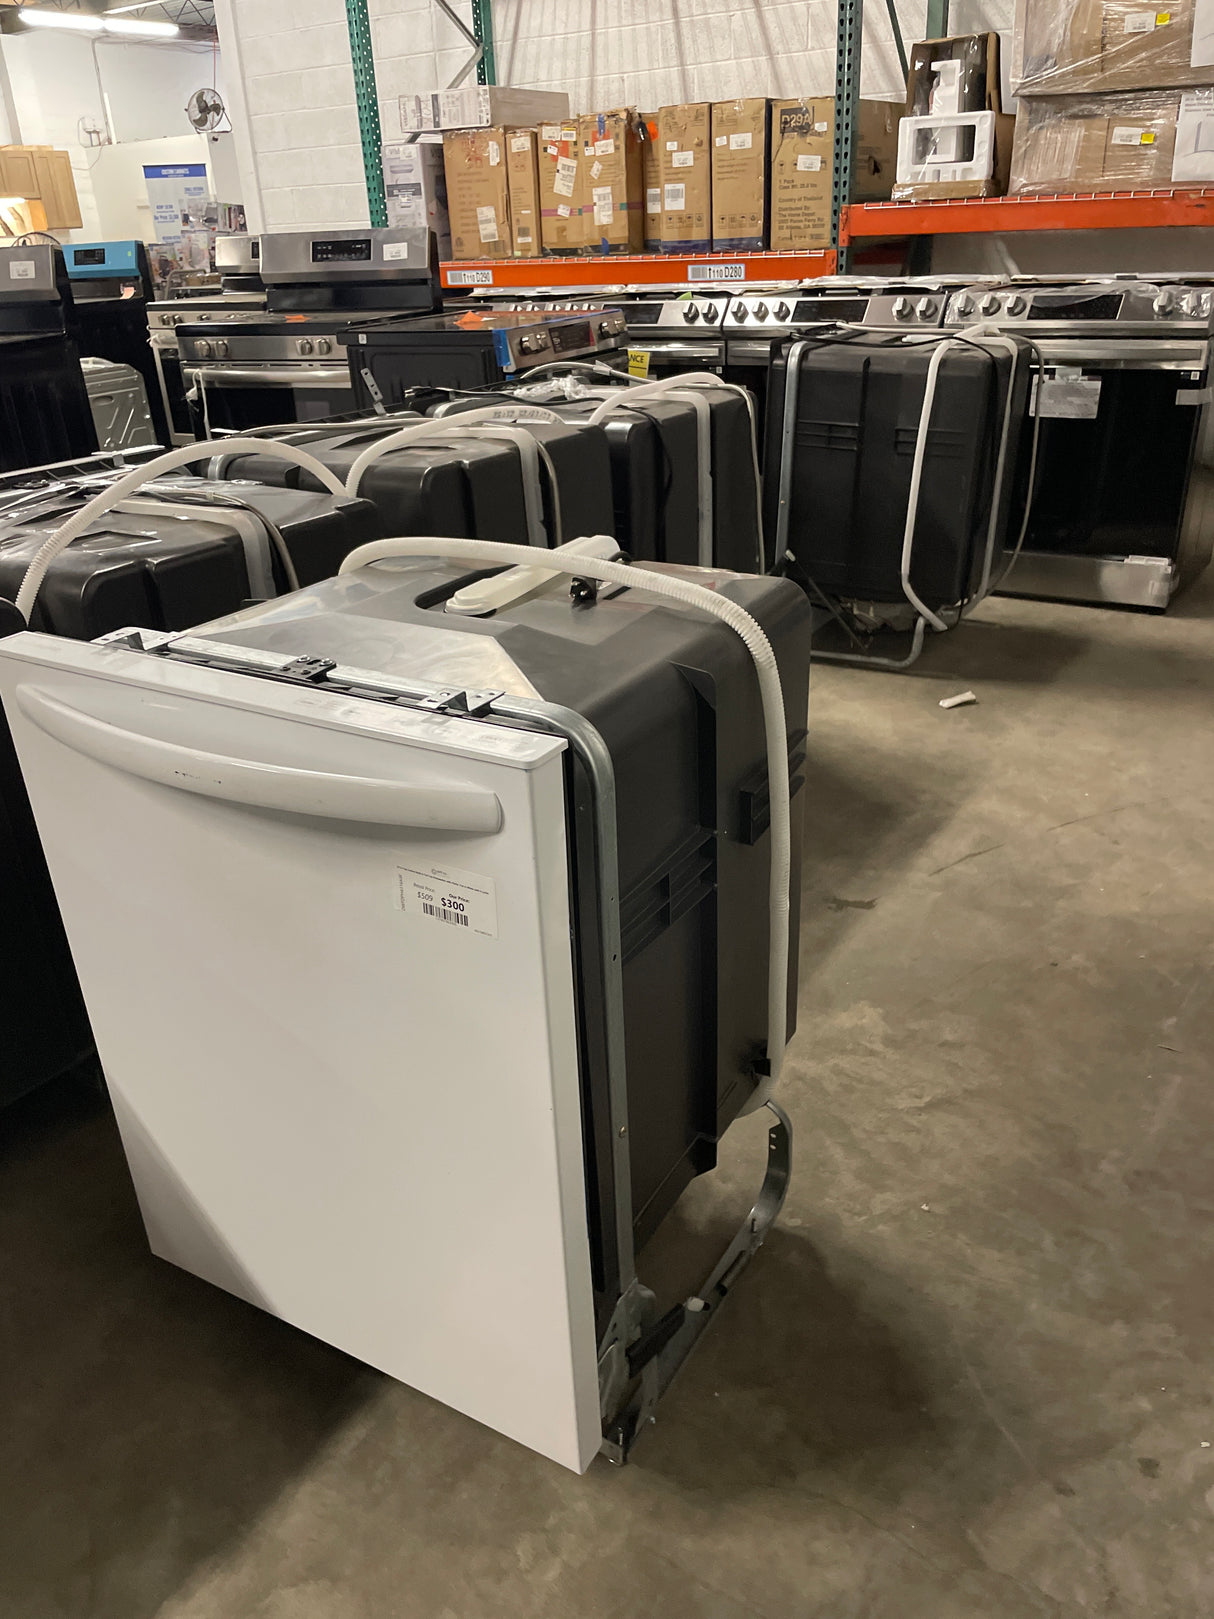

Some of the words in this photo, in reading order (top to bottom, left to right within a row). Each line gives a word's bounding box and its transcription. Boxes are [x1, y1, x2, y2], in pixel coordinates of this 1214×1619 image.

[476, 271, 490, 282] D290
[712, 269, 723, 278] 110
[724, 266, 742, 278] D280
[417, 891, 433, 902] $509
[441, 897, 465, 912] $300
